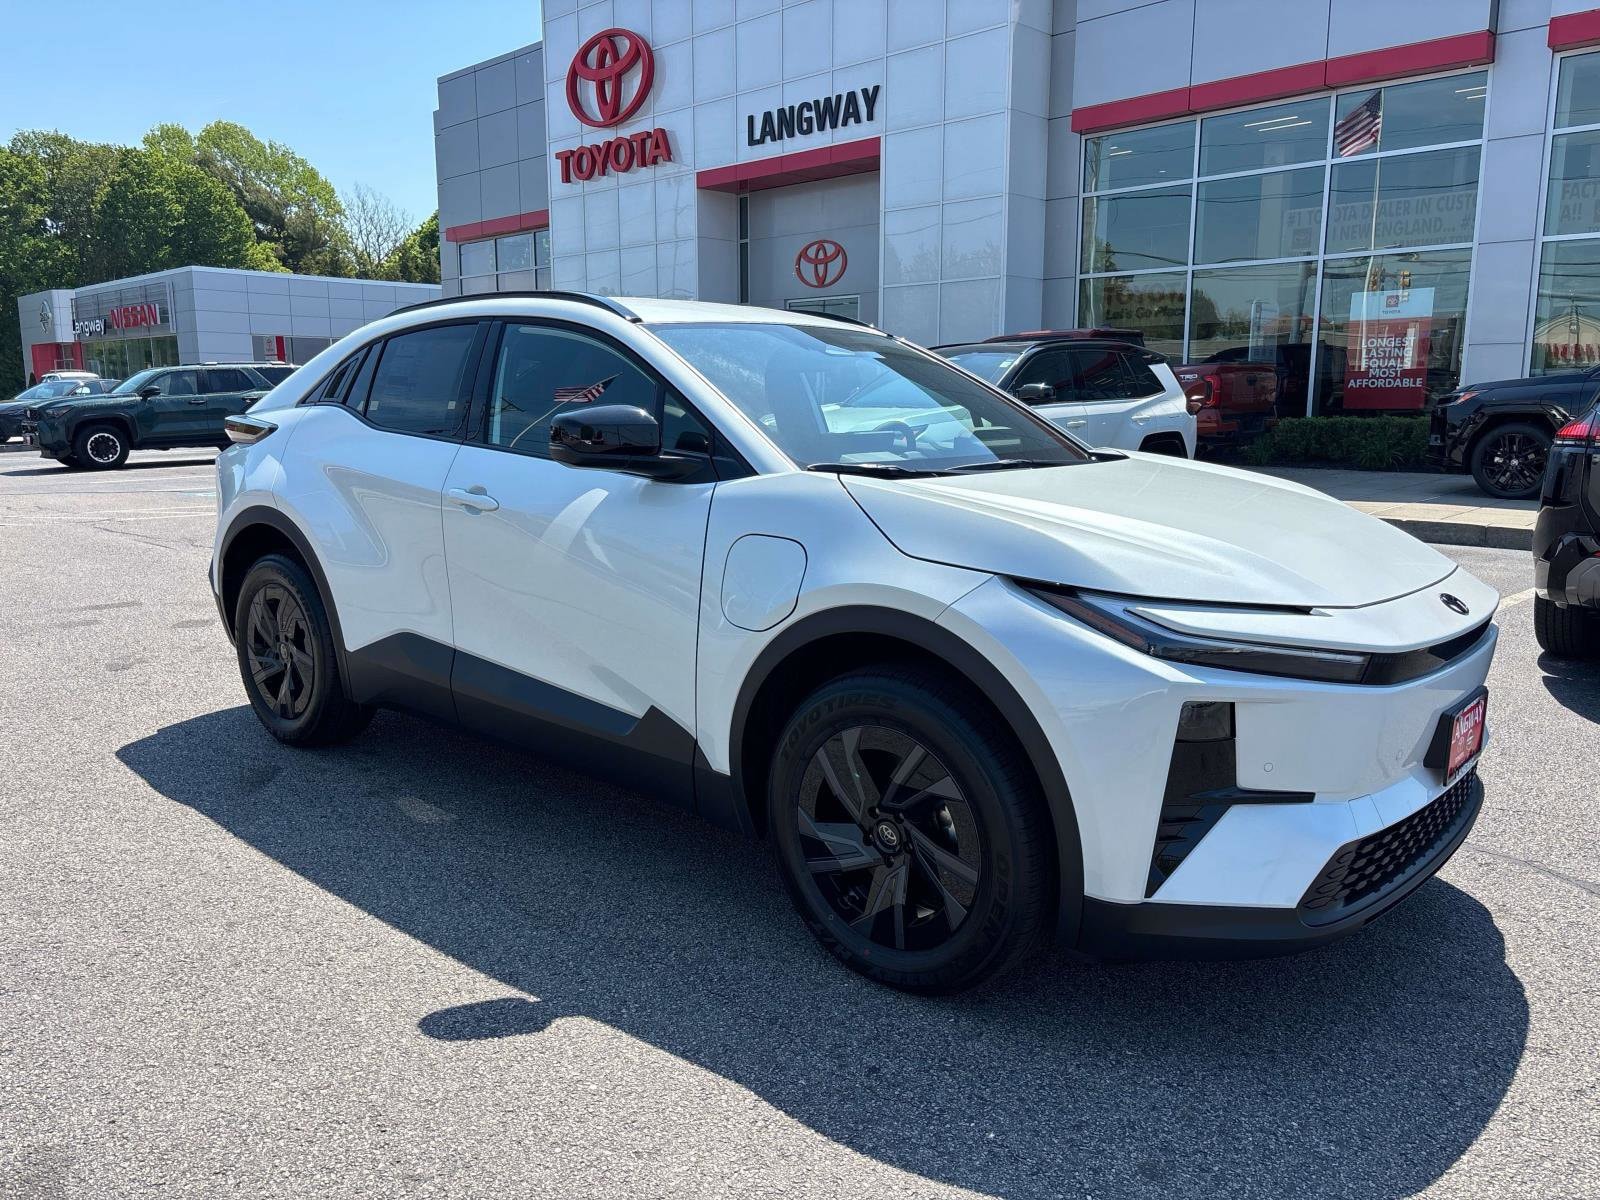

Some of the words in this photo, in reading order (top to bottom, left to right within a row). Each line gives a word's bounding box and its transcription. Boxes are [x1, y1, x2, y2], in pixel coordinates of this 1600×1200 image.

[747, 84, 881, 147] LANGWAY
[555, 127, 674, 184] TOYOTA
[1306, 205, 1357, 225] TOOTA
[1361, 199, 1410, 220] DALER
[1415, 197, 1433, 215] IN
[110, 303, 159, 330] NISSAN
[72, 318, 106, 337] Langway
[1361, 336, 1416, 348] LONGEST
[1362, 347, 1413, 358] LASTING
[1362, 357, 1411, 369] EQUALS
[1369, 367, 1403, 378] MOST
[1347, 377, 1423, 388] AFFORDABLE
